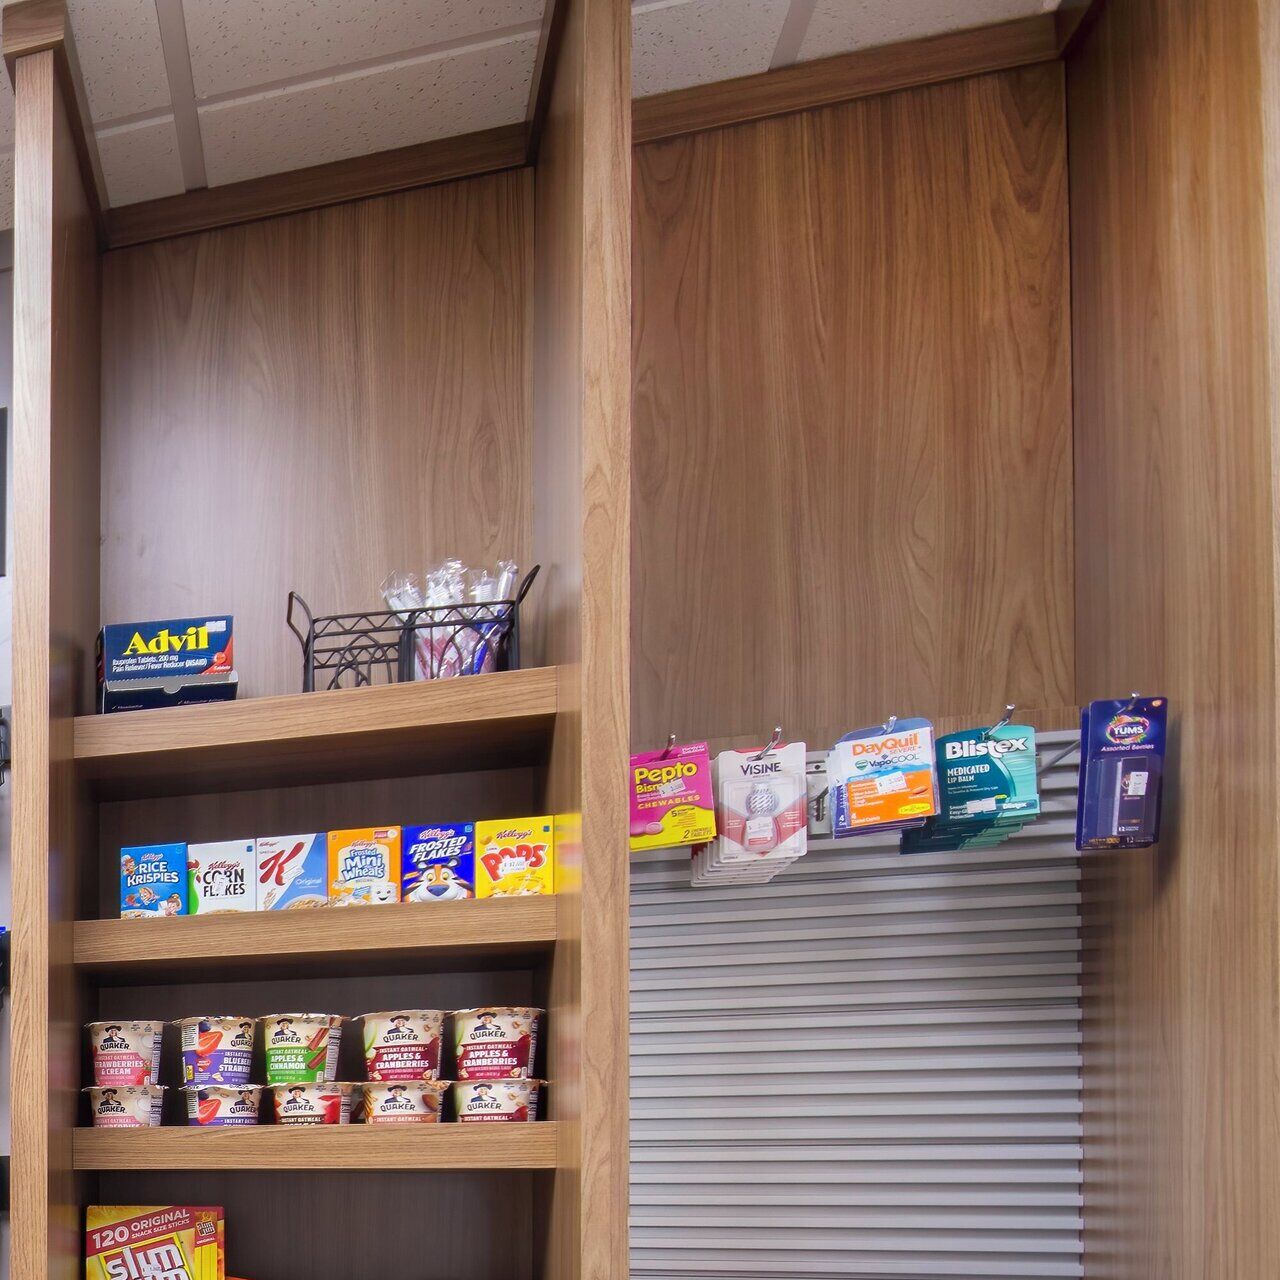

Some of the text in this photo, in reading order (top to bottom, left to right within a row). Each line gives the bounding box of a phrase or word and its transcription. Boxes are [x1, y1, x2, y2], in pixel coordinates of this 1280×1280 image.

[123, 625, 209, 655] Advil
[1113, 726, 1143, 735] TUMS
[853, 733, 918, 757] DayQuil
[945, 738, 1028, 760] Blistex
[634, 762, 697, 784] Pepto
[741, 762, 781, 776] VISINE
[947, 764, 990, 777] MEDICATED
[958, 775, 974, 783] BALM
[638, 795, 700, 810] CHEWABLES
[683, 830, 689, 839] 2
[409, 836, 467, 855] FROSTED
[350, 849, 377, 857] Frosted
[412, 846, 462, 863] FLAKES
[138, 861, 168, 874] RICE
[342, 866, 386, 882] Wheats
[127, 871, 180, 887] KRISPIES
[383, 1033, 418, 1043] QUAKER
[470, 1031, 506, 1039] QUAKER
[272, 1036, 301, 1044] QUAKER
[100, 1043, 130, 1051] QUAKER
[271, 1055, 303, 1063] APPLES &
[382, 1053, 421, 1061] APPLES &
[469, 1050, 509, 1059] APPLES &
[270, 1062, 306, 1070] CINNAMON
[376, 1060, 429, 1069] CRANBERRIES
[463, 1058, 517, 1067] CRANBERRIES
[97, 1106, 126, 1114] QUAKER
[229, 1106, 257, 1114] QUAKER
[283, 1105, 315, 1113] QUAKER
[380, 1103, 416, 1111] QUAKER
[467, 1102, 502, 1111] QUAKER
[92, 1209, 190, 1249] 120 ORIGINAL
[131, 1218, 190, 1239] SNACK SIZE STICKS
